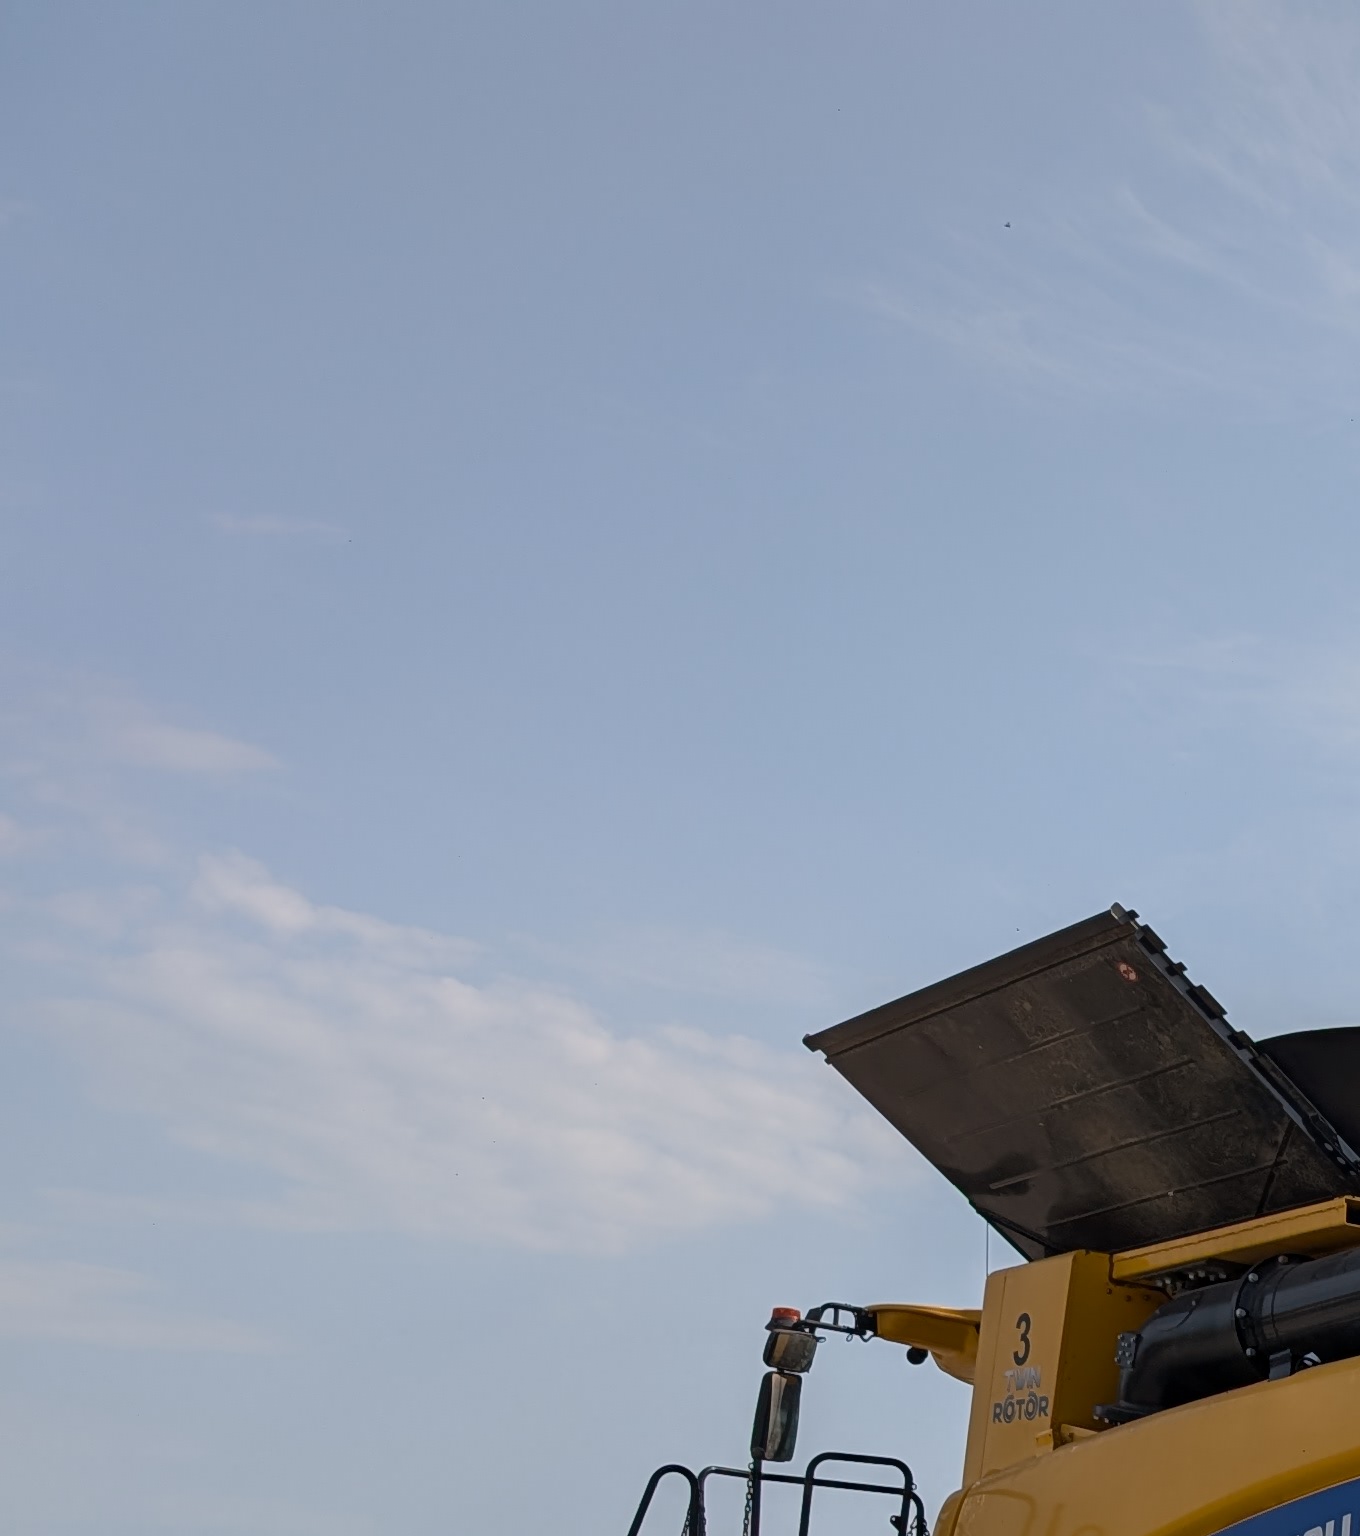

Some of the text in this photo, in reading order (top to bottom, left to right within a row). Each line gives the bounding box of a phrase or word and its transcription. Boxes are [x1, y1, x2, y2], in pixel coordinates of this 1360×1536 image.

[1013, 1312, 1031, 1366] 3
[1004, 1366, 1041, 1392] TWIN
[992, 1391, 1049, 1424] ROTOR
